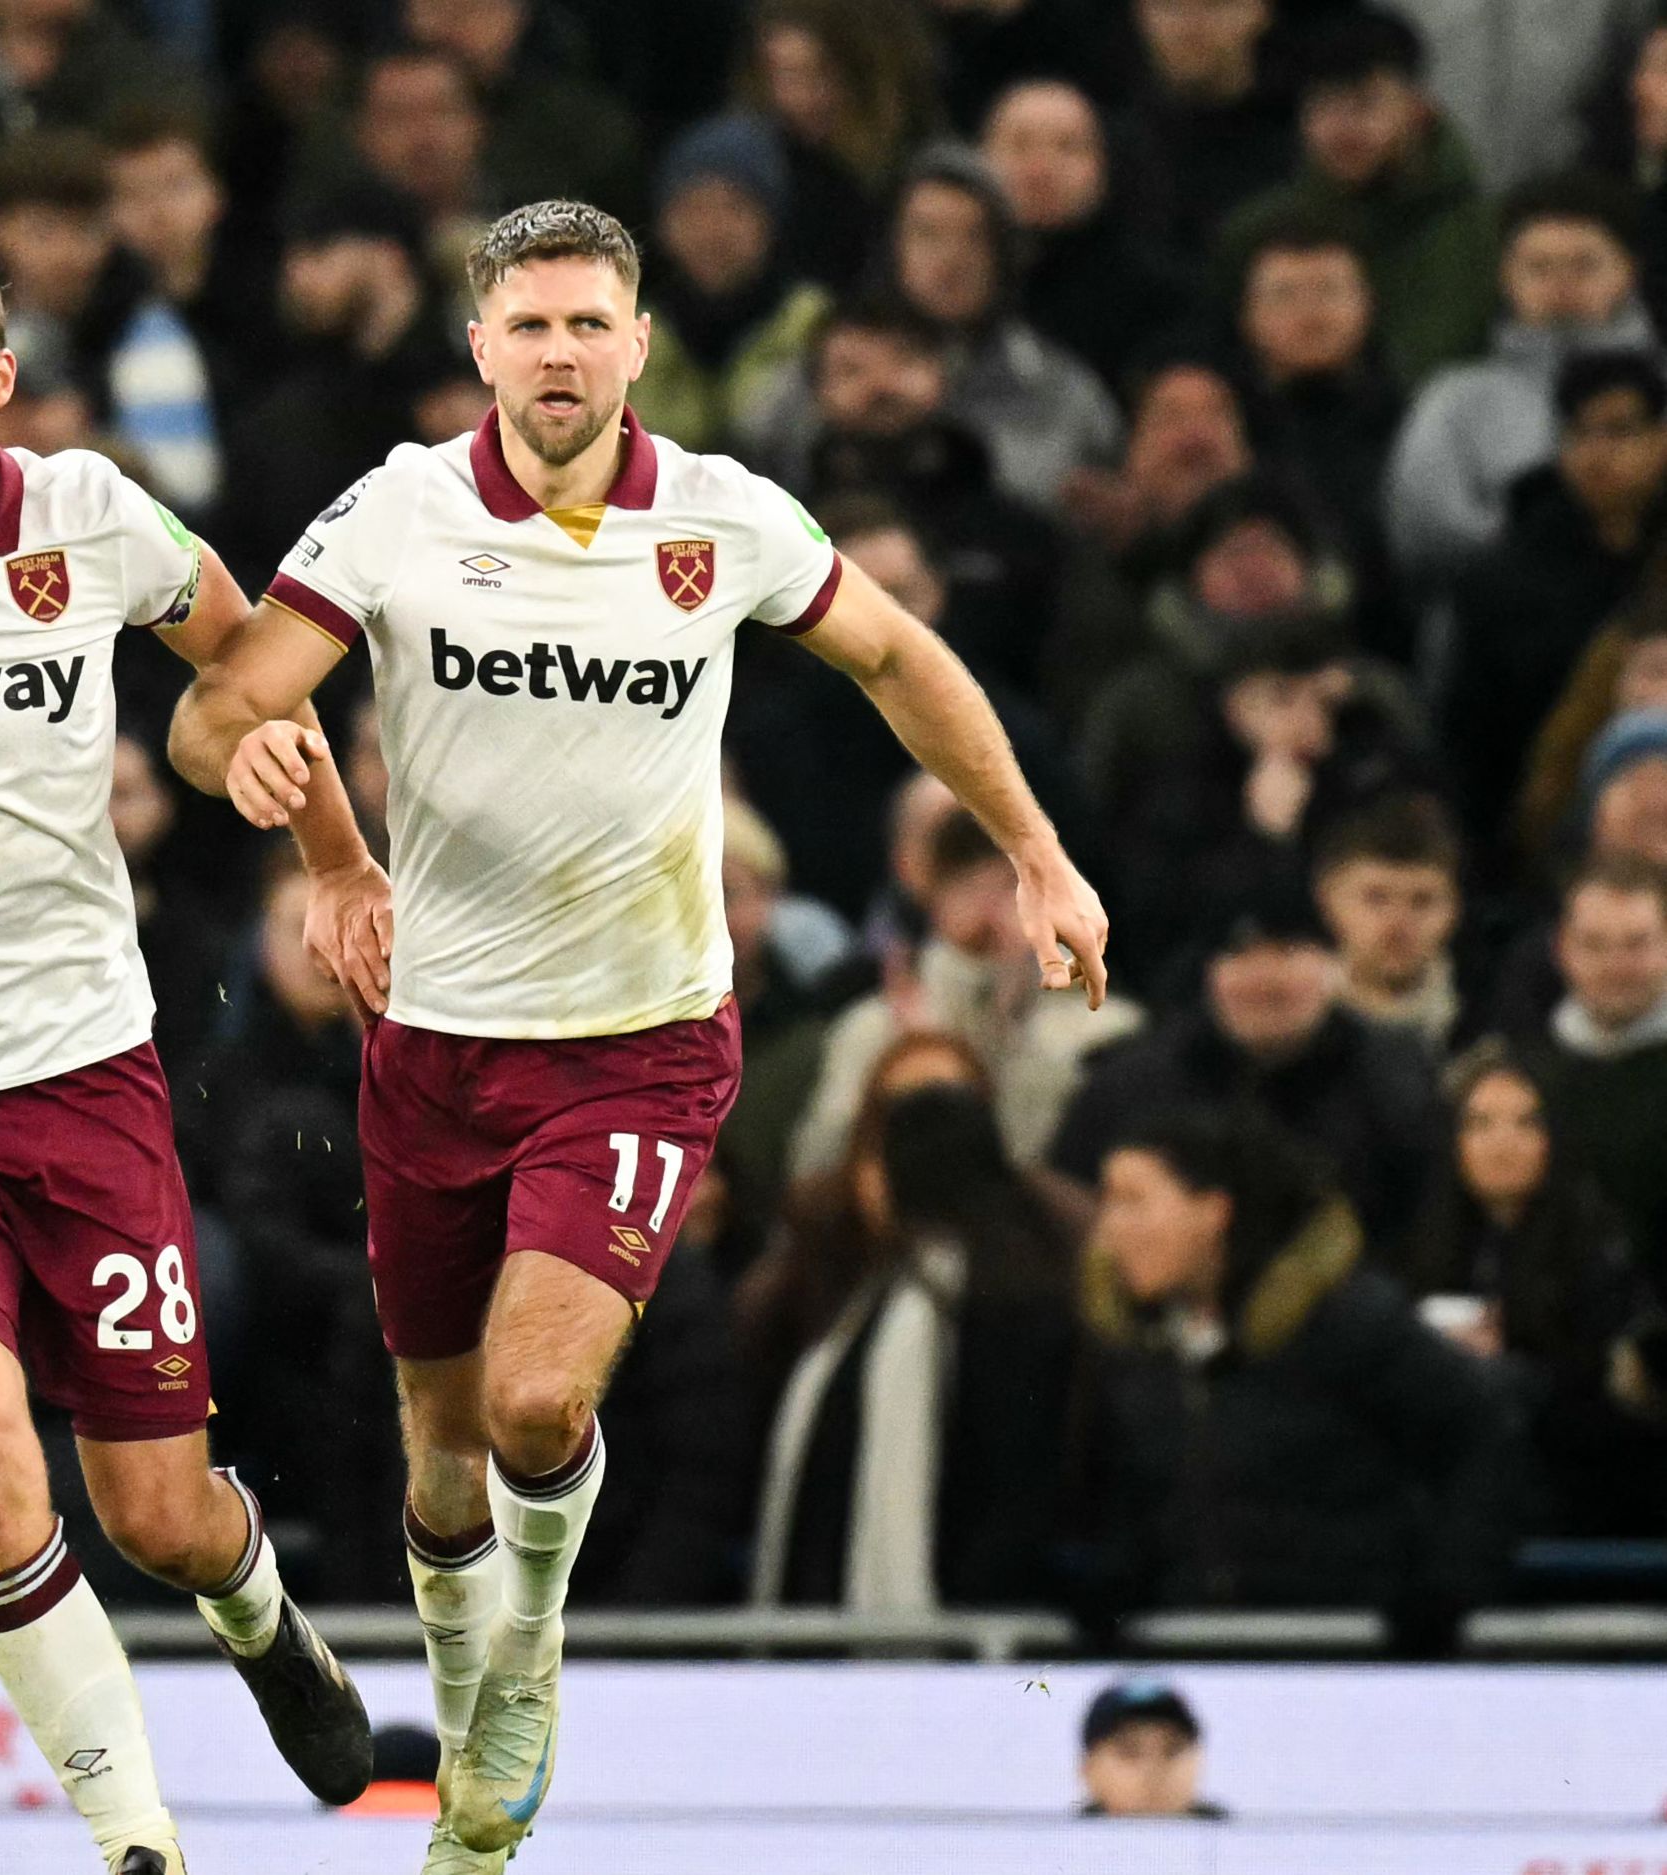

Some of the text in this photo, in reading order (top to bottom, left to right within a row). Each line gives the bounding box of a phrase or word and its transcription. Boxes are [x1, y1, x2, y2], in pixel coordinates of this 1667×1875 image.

[661, 542, 710, 553] WEST HAM
[10, 553, 61, 570] WEST HAM
[462, 577, 502, 588] umbro
[430, 627, 708, 720] betway
[607, 1132, 684, 1234] 11
[608, 1242, 641, 1267] umbro
[91, 1244, 196, 1350] 28
[158, 1380, 189, 1391] umbro
[73, 1765, 113, 1783] umbro
